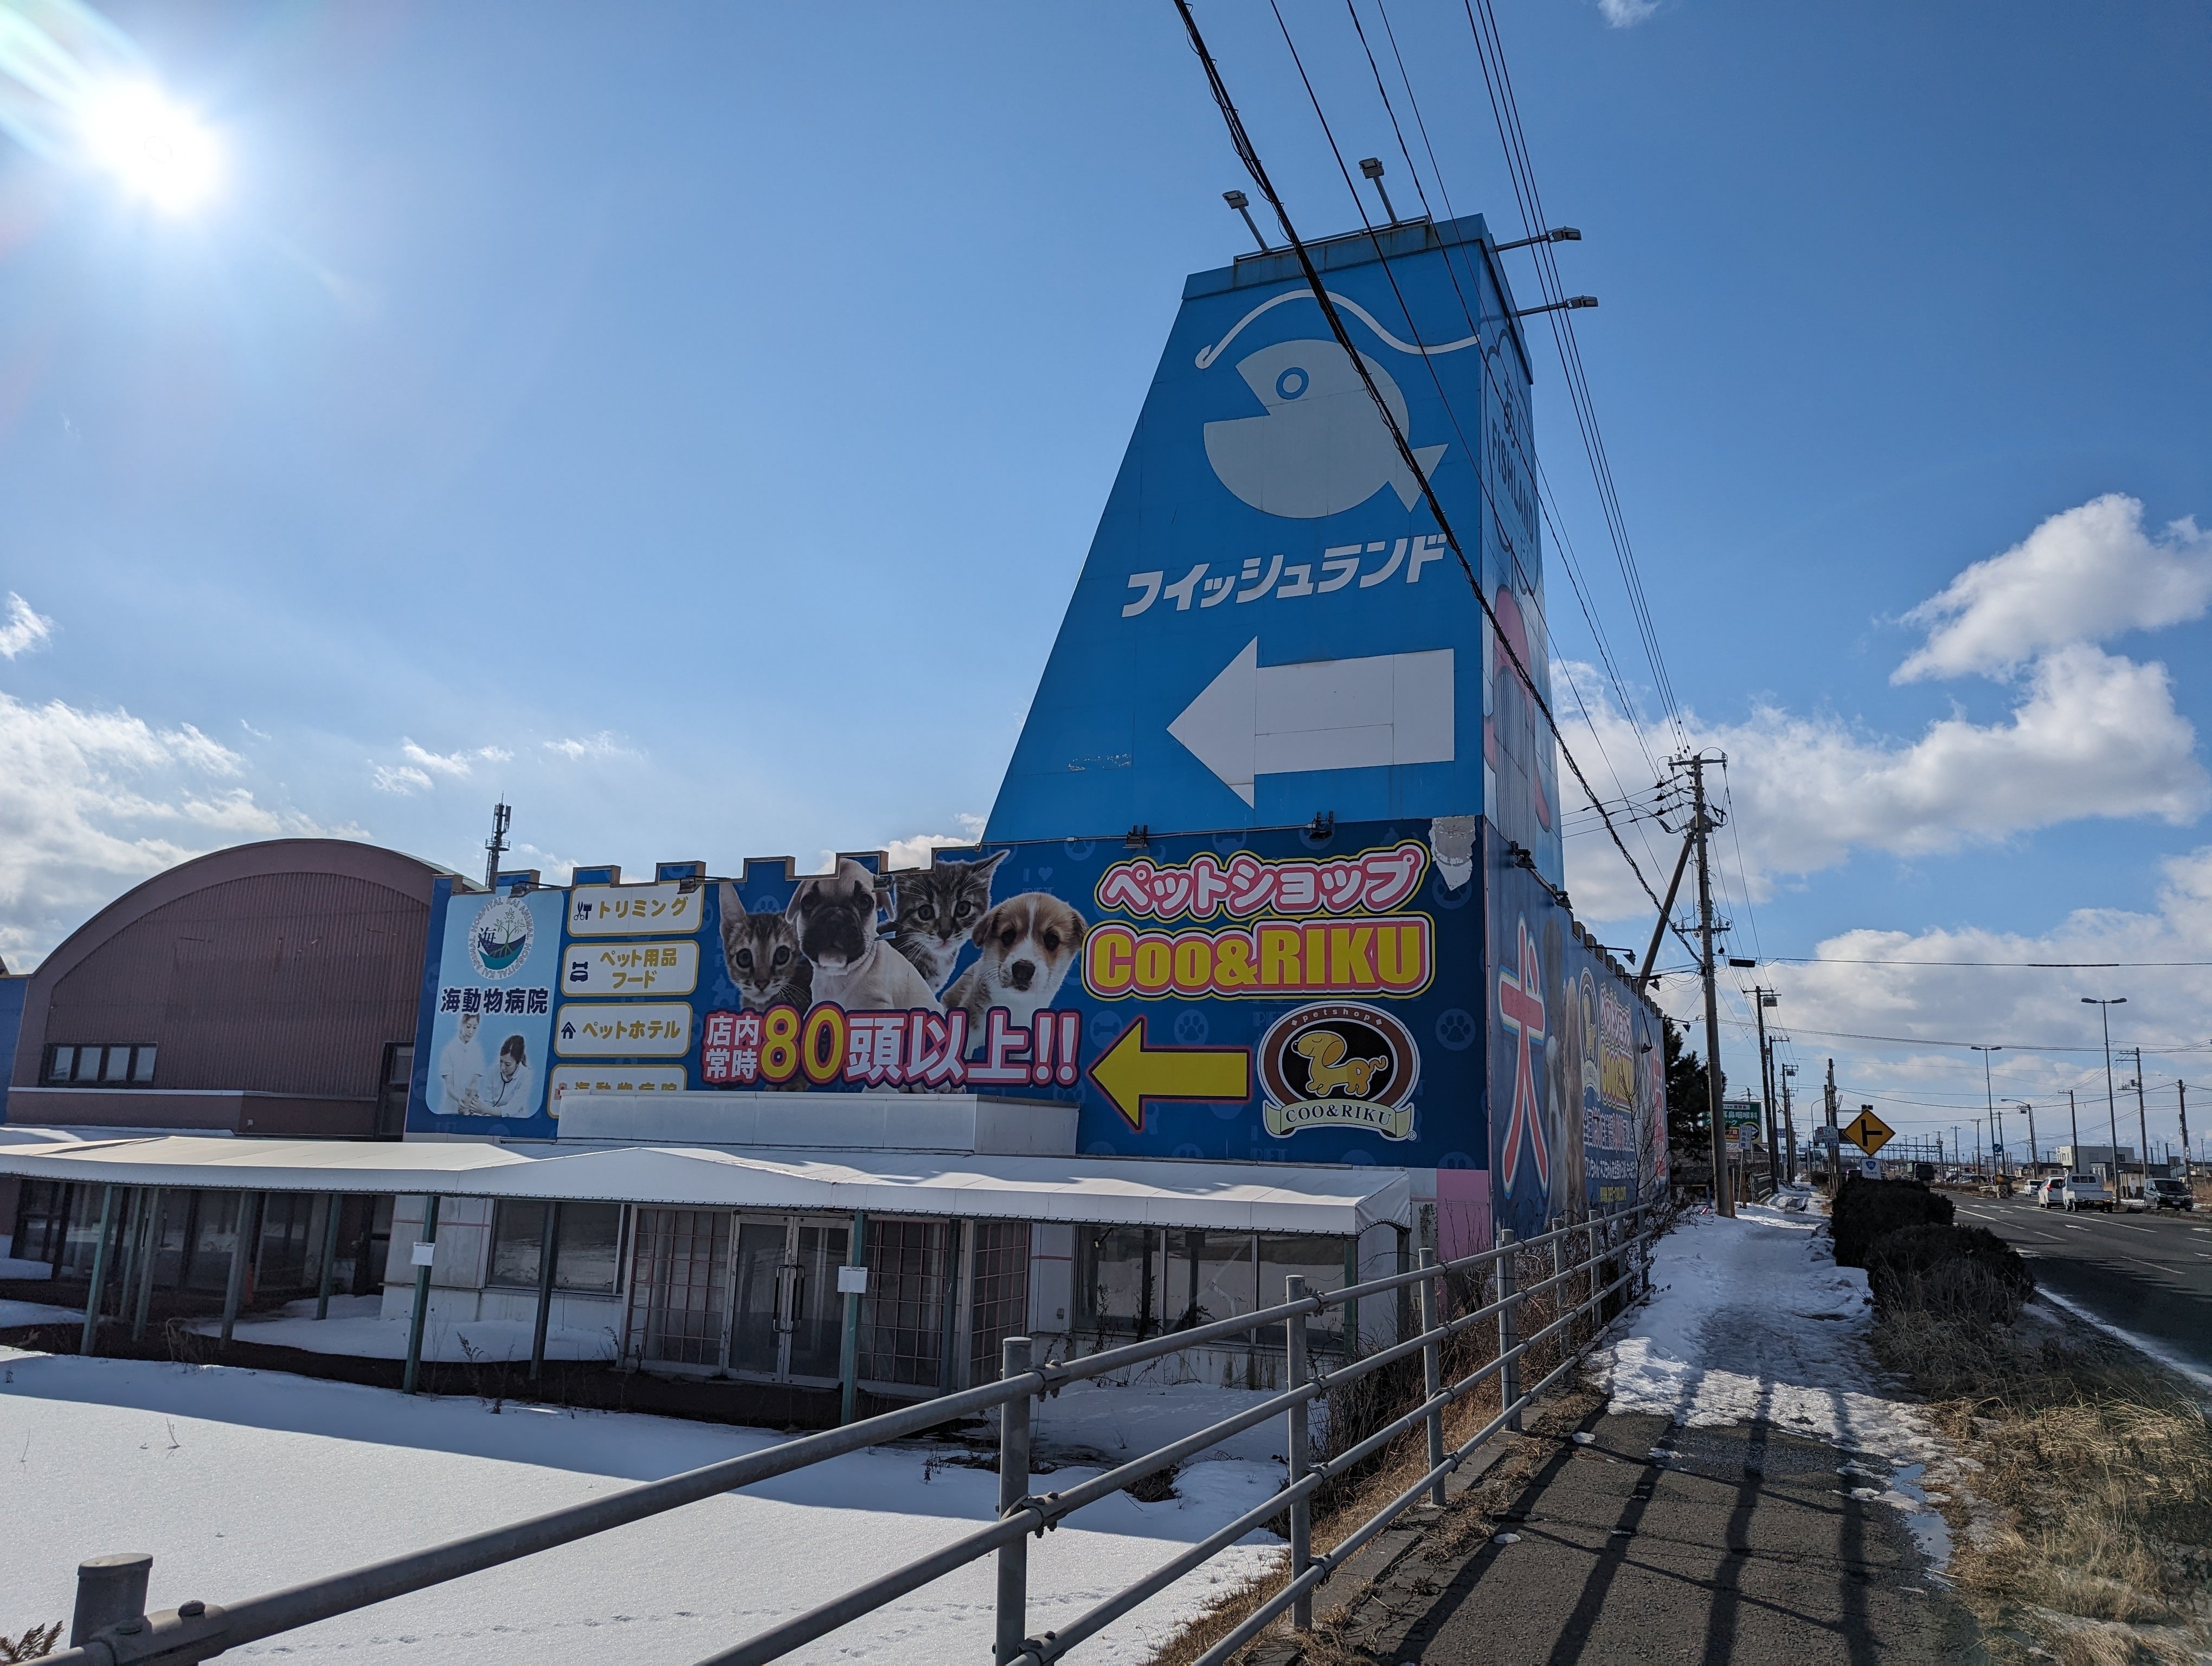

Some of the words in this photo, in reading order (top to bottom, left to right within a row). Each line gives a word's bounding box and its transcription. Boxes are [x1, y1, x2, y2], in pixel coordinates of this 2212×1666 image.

[1492, 418, 1534, 544] FISHLAND
[1106, 853, 1415, 909] ペットショップ
[471, 898, 503, 932] HOSPITAL
[599, 896, 689, 919] トリミング
[600, 948, 677, 967] ペット用品
[613, 970, 657, 989] フード
[440, 988, 549, 1014] 海動物病院
[1302, 1008, 1371, 1023] petshop
[583, 1021, 680, 1040] ペットホテル
[706, 1016, 758, 1046] 店内
[706, 1048, 757, 1079] 常時
[1501, 922, 1547, 1185] 犬
[1285, 1105, 1392, 1125] COO&RIKU
